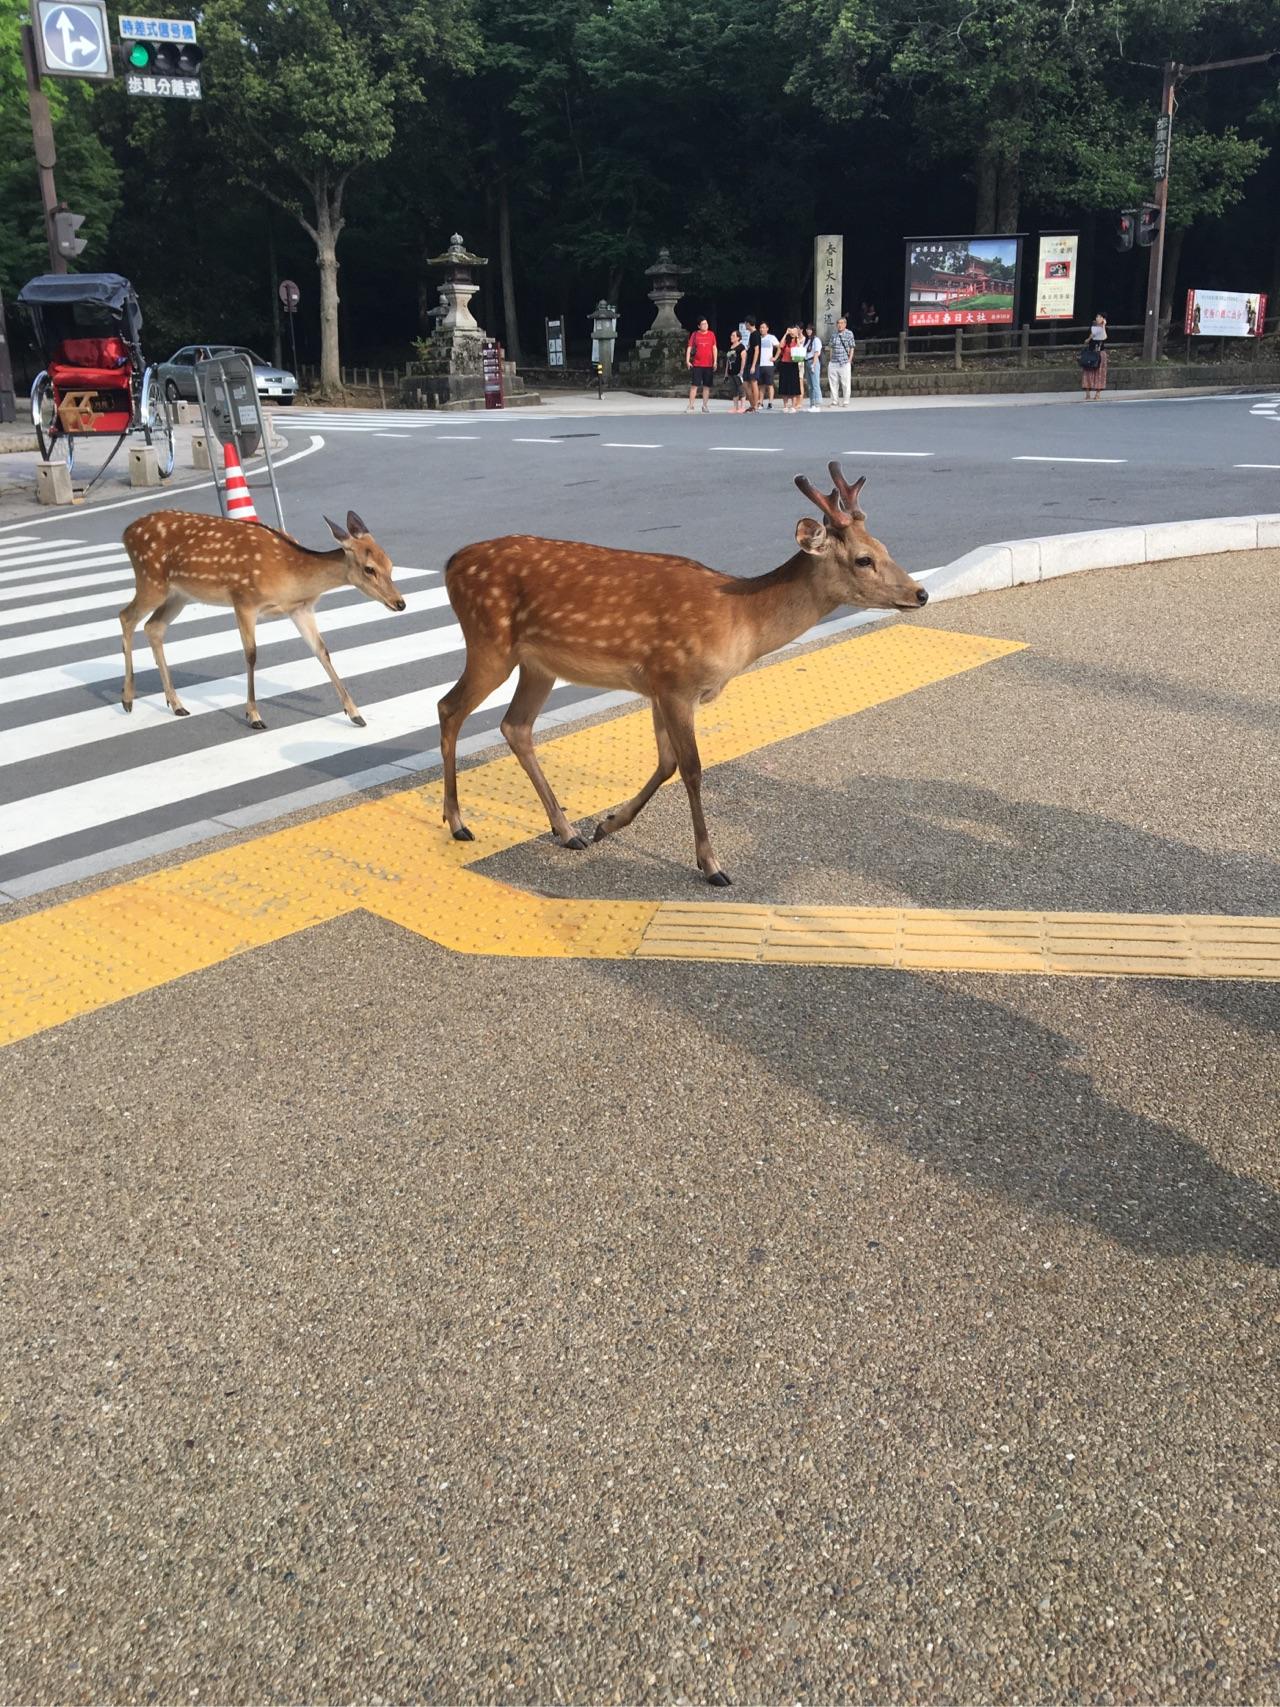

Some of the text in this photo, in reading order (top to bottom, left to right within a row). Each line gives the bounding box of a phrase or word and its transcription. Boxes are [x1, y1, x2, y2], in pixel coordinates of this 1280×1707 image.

[122, 20, 194, 39] 時差式信号機
[128, 77, 199, 97] 歩車分離式
[824, 242, 838, 325] 春日大社参道
[943, 312, 987, 324] 春日大社
